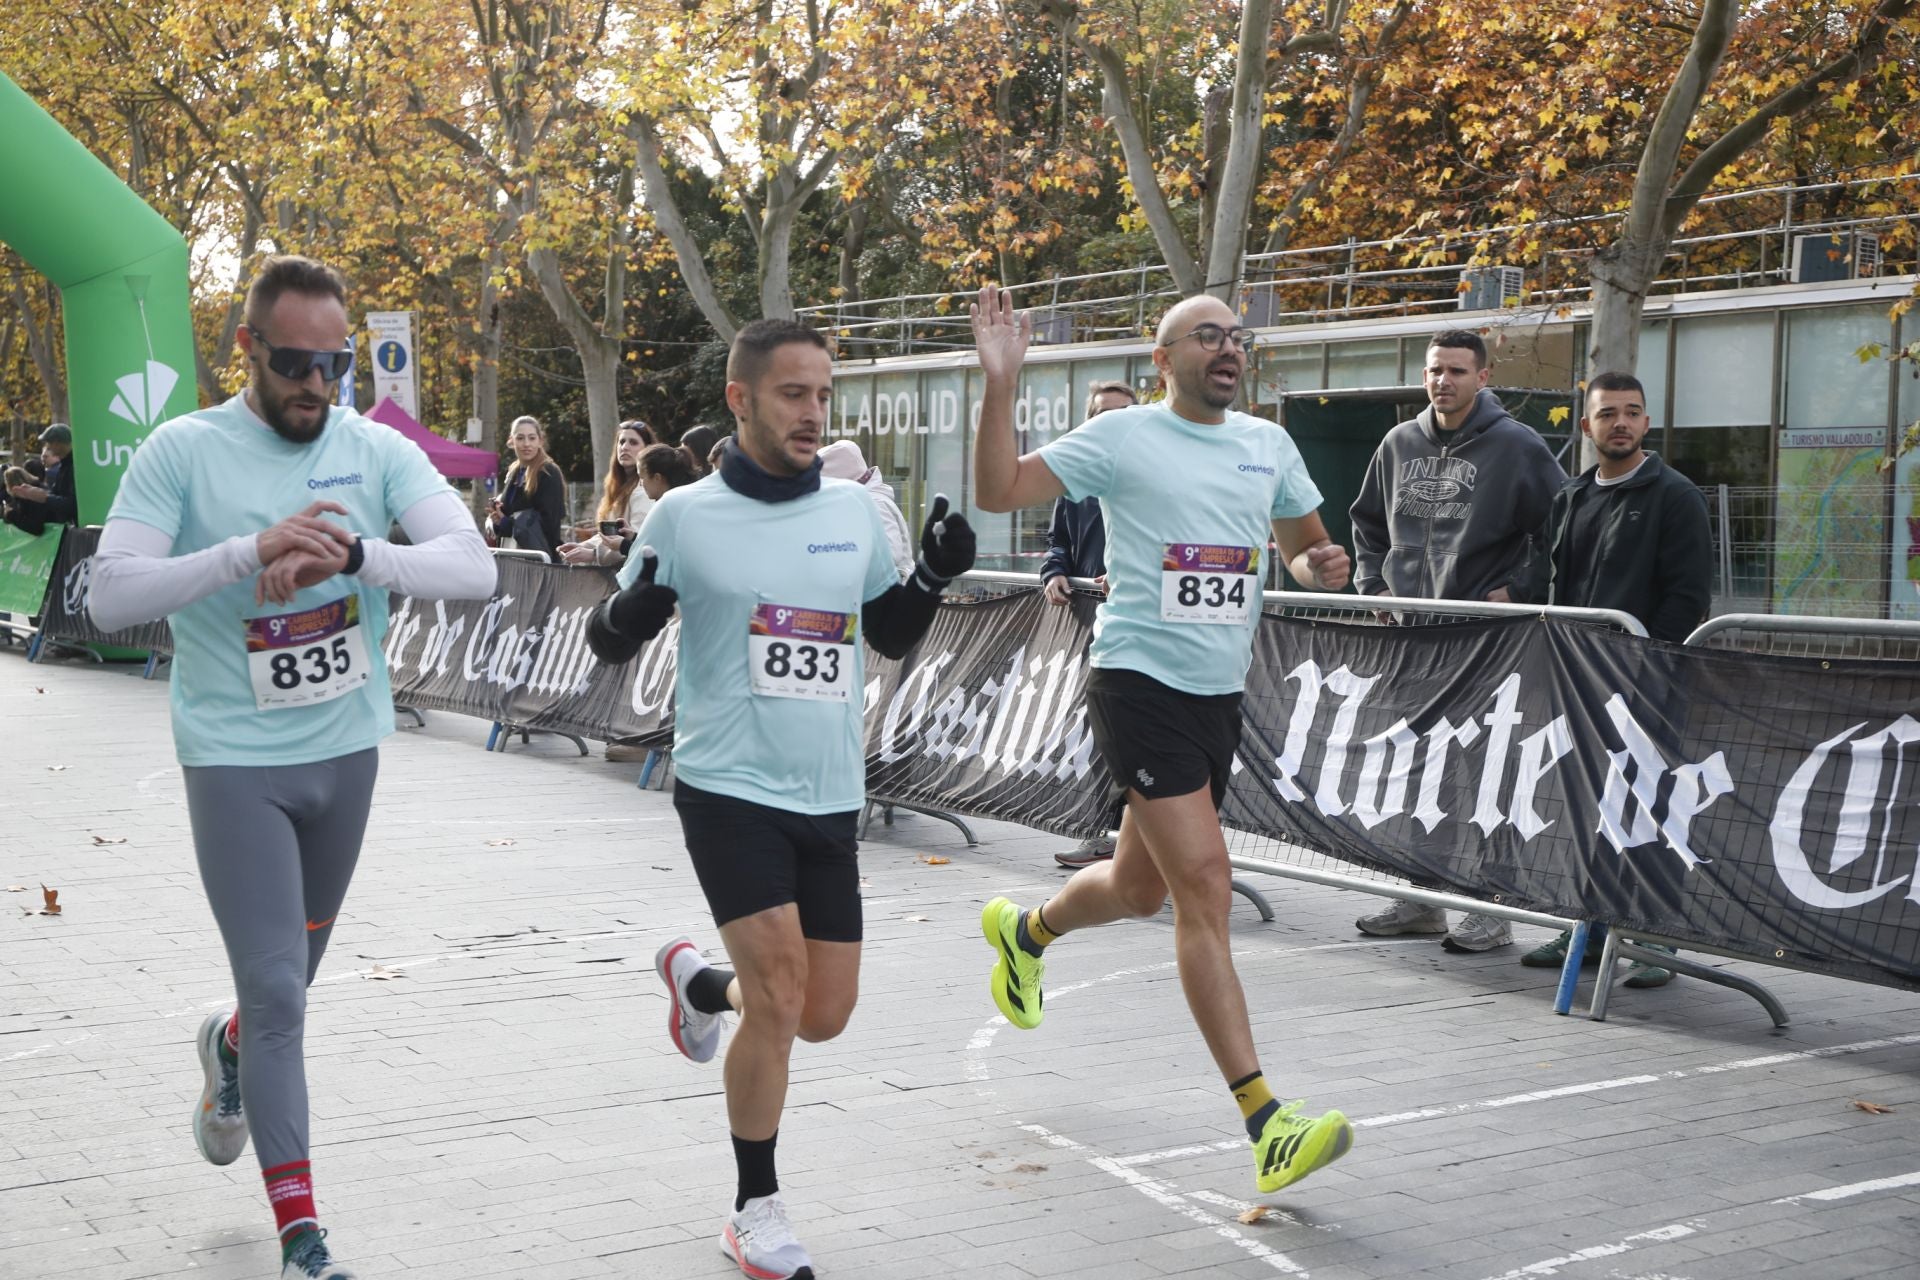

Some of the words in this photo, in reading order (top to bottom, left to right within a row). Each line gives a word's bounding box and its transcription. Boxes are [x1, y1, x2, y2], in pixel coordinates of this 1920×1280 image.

[821, 389, 958, 437] LLADOLID
[970, 384, 1070, 431] cdad
[1792, 434, 1825, 446] TURISMO
[1826, 432, 1873, 445] VALLADOLID
[1401, 456, 1478, 492] UNLIKE
[1178, 575, 1245, 609] 834
[418, 599, 465, 678] de
[764, 641, 840, 683] 833
[270, 636, 351, 690] 835
[1273, 658, 1574, 842] Norte
[1597, 693, 1734, 871] de
